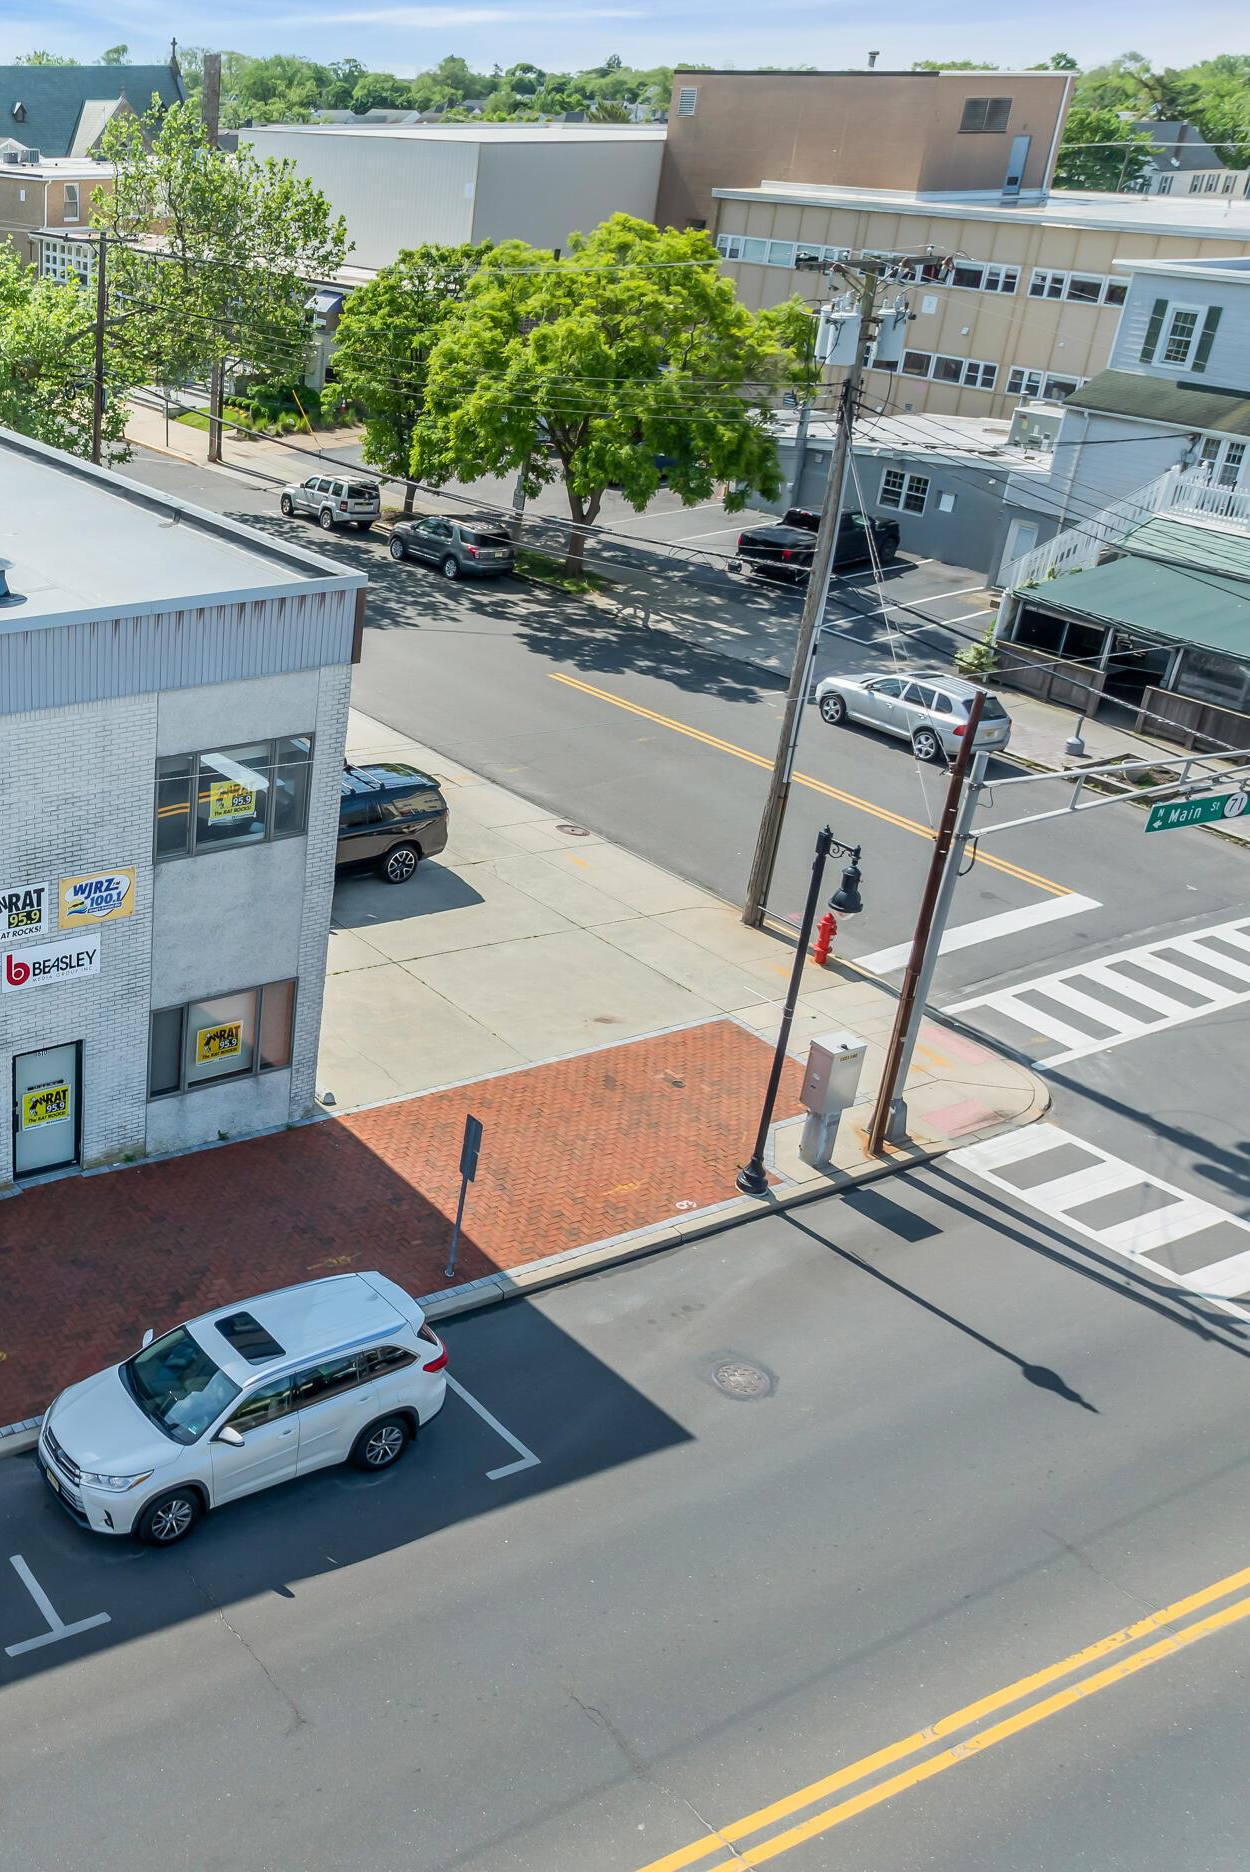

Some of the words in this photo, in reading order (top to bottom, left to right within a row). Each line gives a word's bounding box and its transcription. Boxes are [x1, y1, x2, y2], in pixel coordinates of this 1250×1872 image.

[233, 795, 252, 806] 95.9
[1229, 798, 1244, 812] 71
[1157, 808, 1165, 817] N
[1168, 806, 1202, 824] Main
[1211, 801, 1220, 811] St
[73, 878, 119, 900] WJRZ
[90, 891, 122, 907] 100.1
[10, 910, 40, 928] 95.9
[12, 925, 42, 937] ROCKS!
[32, 949, 97, 977] BEASLEY
[220, 1038, 237, 1049] 95.9
[46, 1102, 65, 1113] 95.9
